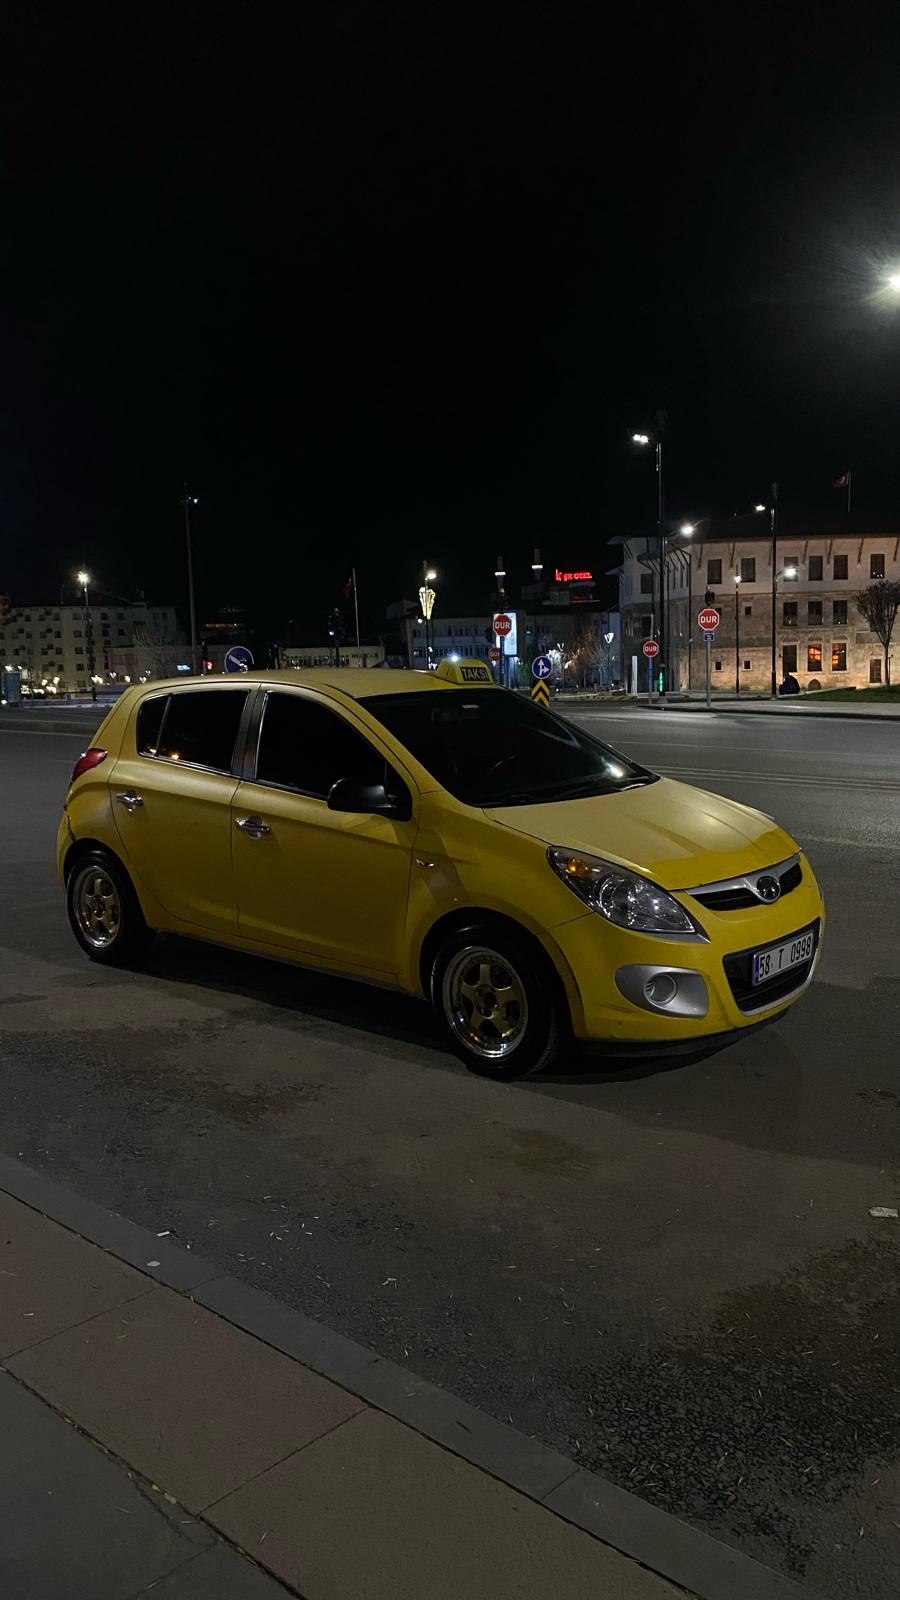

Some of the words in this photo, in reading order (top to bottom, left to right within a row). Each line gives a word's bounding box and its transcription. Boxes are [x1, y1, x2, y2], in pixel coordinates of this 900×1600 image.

[700, 615, 717, 624] DUR
[494, 621, 510, 629] DUR
[760, 954, 771, 978] 58
[779, 948, 784, 969] T
[791, 936, 812, 962] 0998
